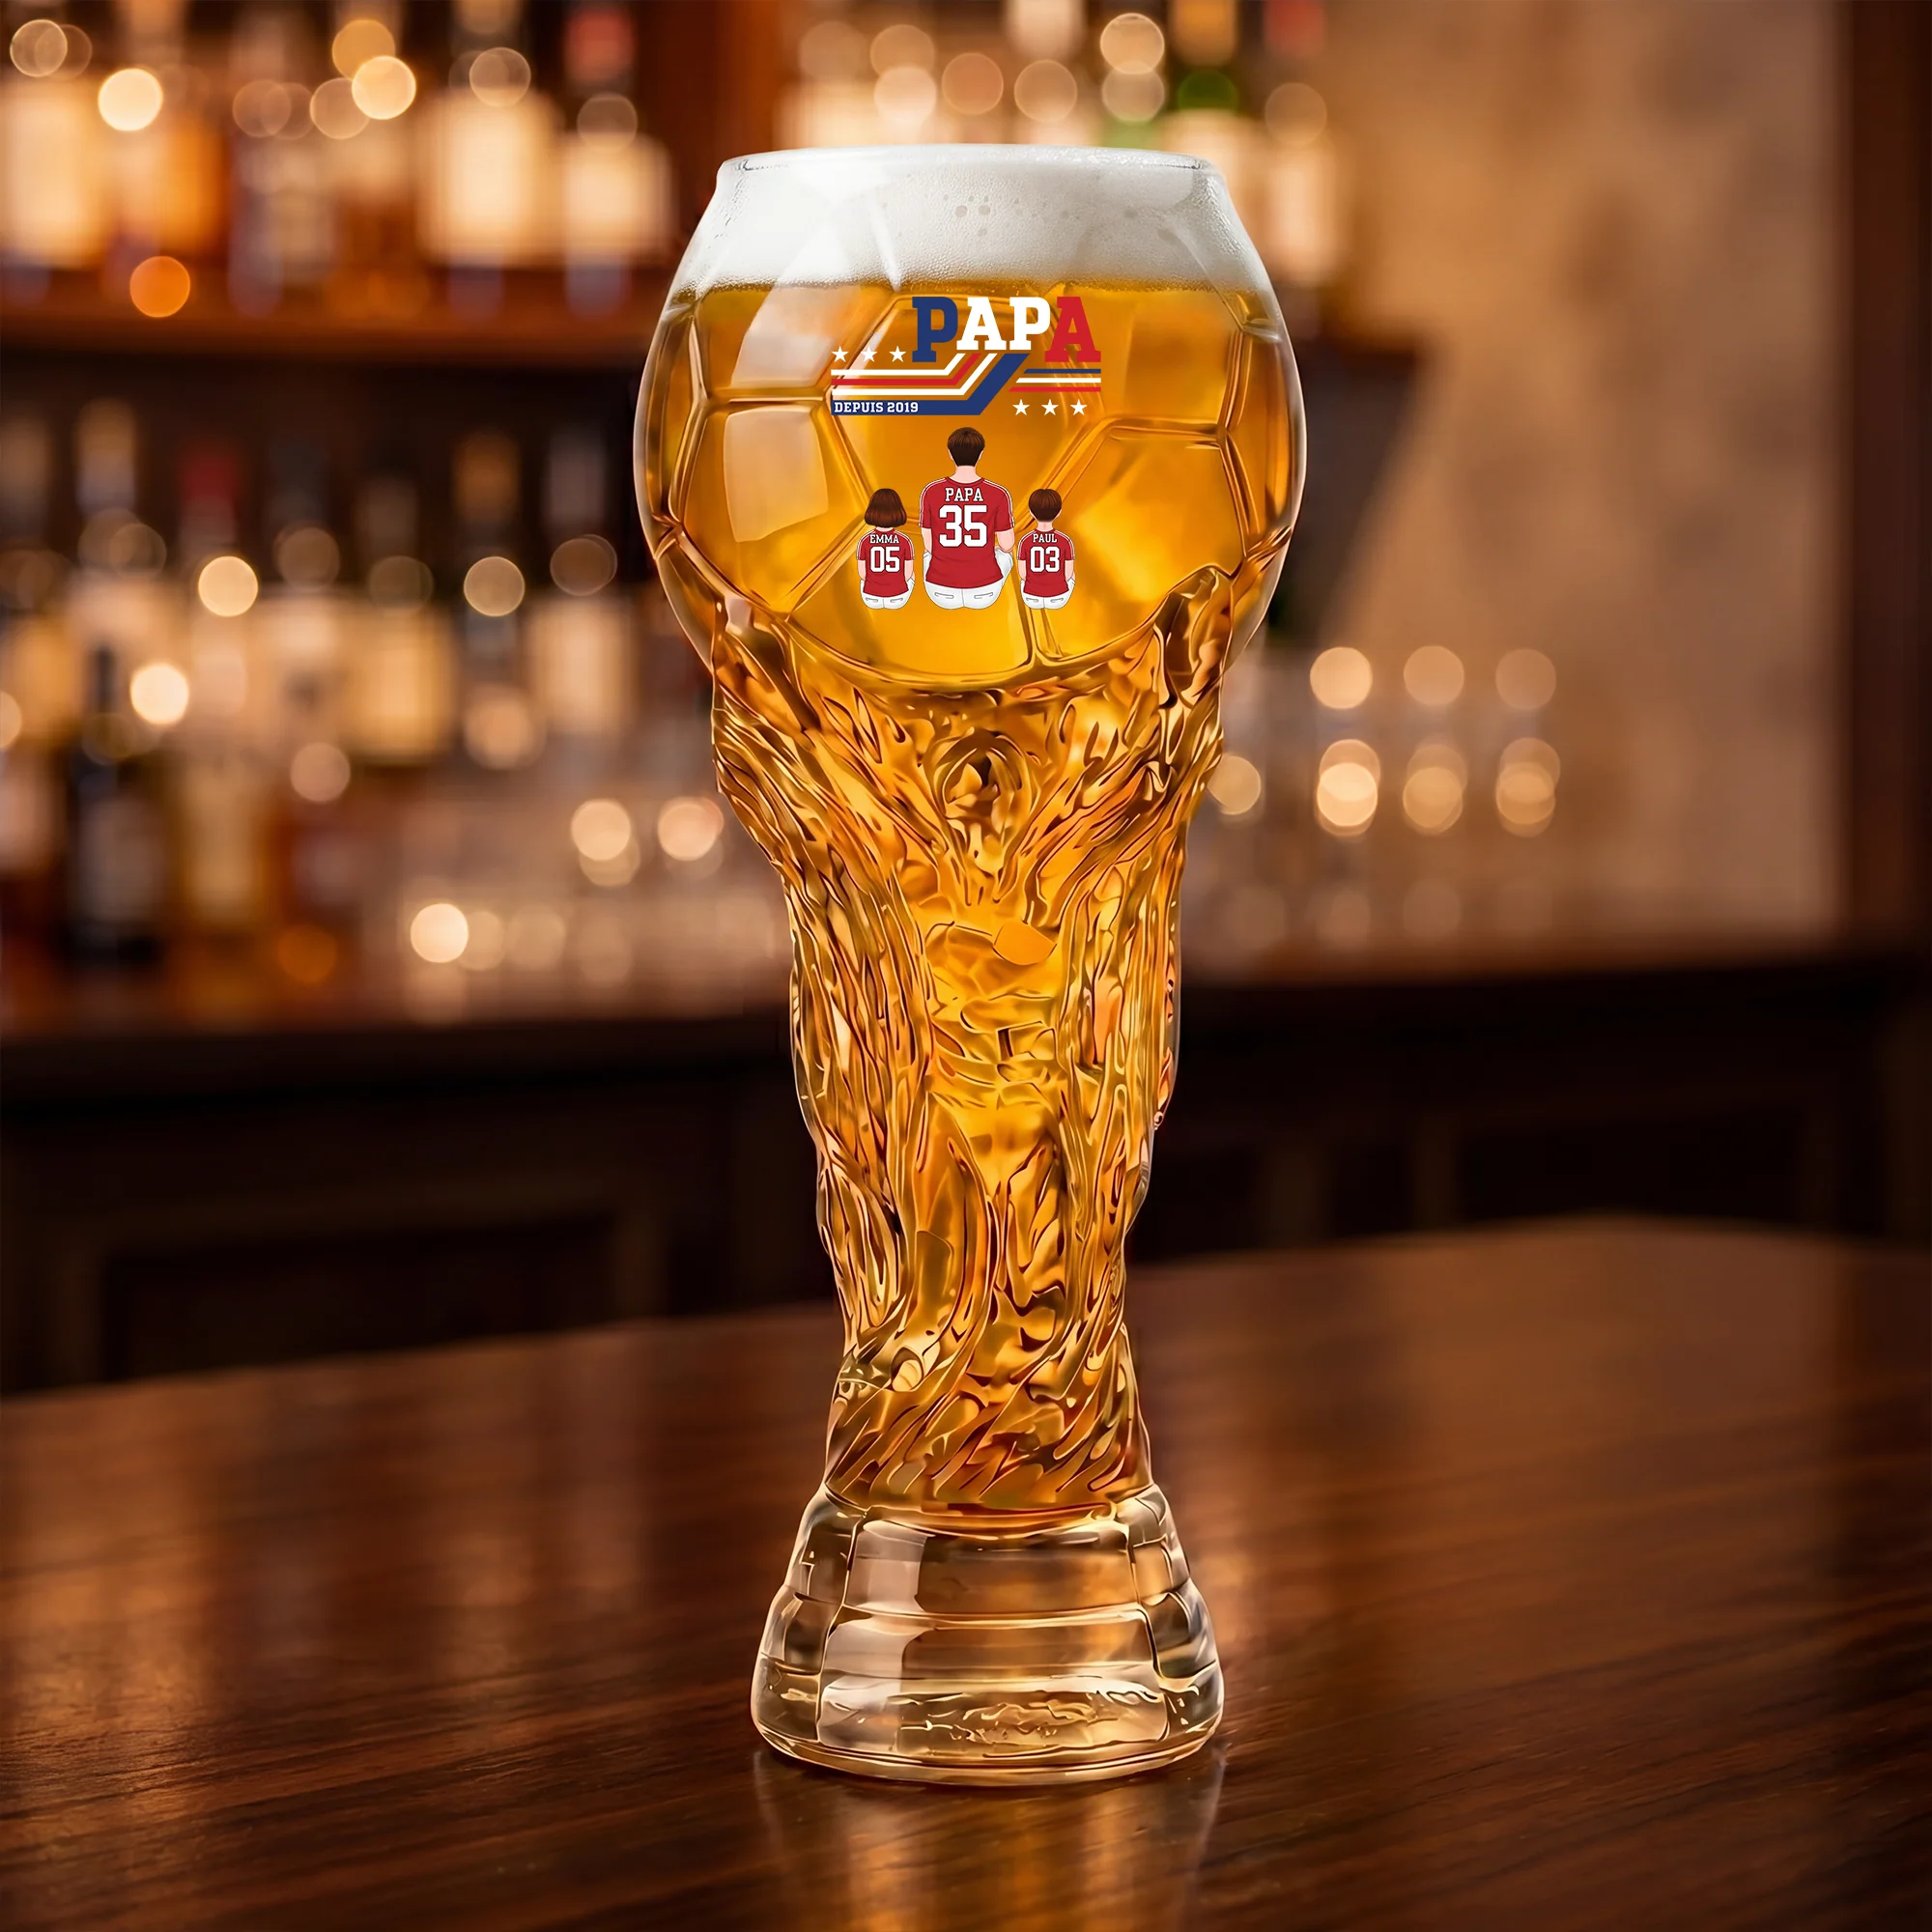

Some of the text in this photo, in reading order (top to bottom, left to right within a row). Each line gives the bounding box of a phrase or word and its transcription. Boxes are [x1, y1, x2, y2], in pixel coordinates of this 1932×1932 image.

[912, 297, 1101, 362] PAPA
[834, 401, 919, 412] DEPUIS 2019
[945, 487, 983, 501] PAPA
[939, 504, 987, 548] 35
[869, 534, 899, 544] EMMA
[1032, 533, 1058, 543] PAUL
[869, 546, 900, 573] 05
[1030, 546, 1060, 573] 03
